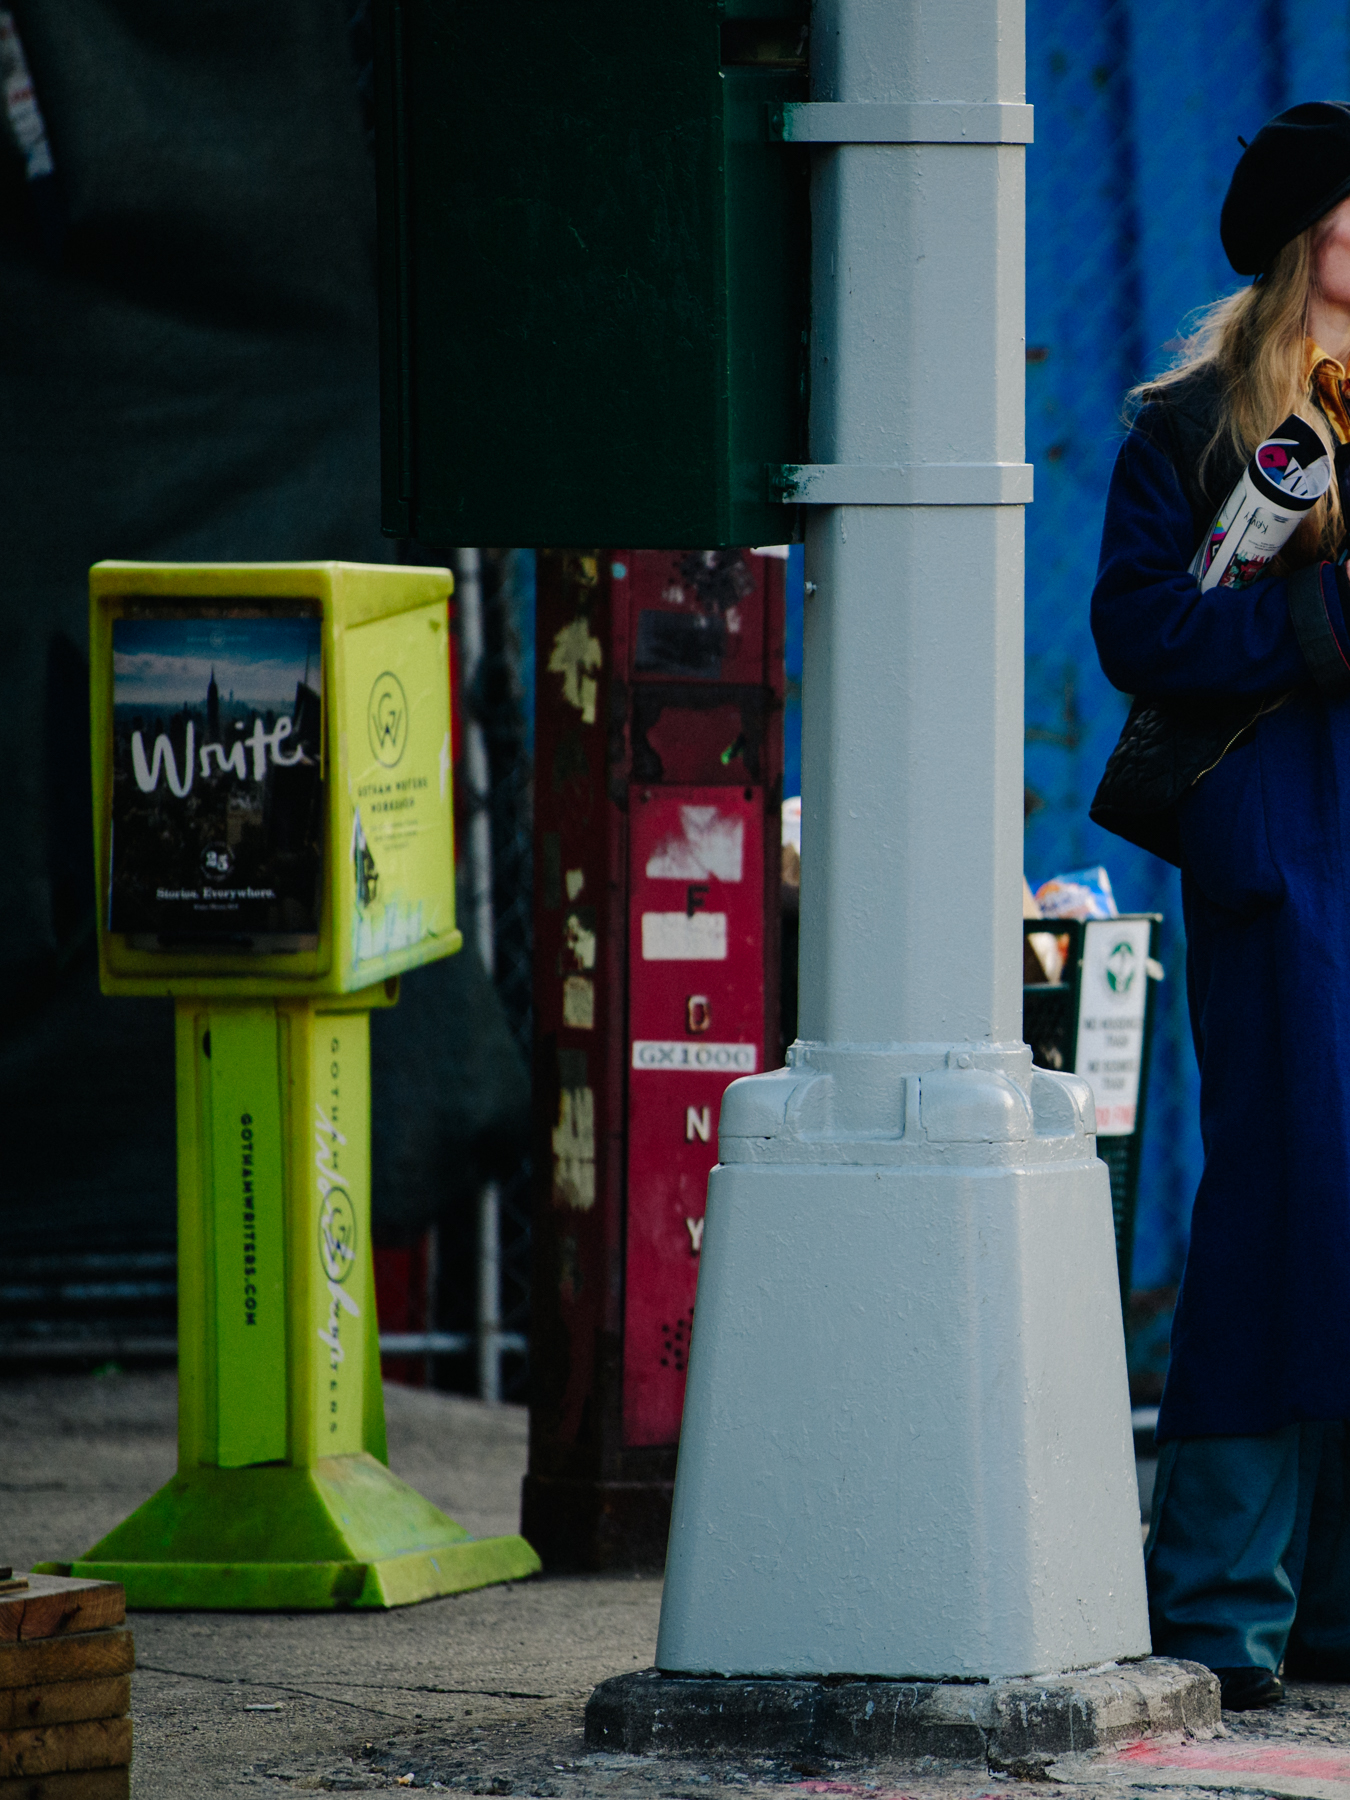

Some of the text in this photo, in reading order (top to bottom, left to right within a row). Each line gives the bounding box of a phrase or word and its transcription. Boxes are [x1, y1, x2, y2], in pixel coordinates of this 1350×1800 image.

[131, 715, 304, 799] Write
[205, 851, 229, 872] 25
[638, 1043, 751, 1069] GX1000
[240, 1112, 258, 1326] GOTHAMWRITERS.COM
